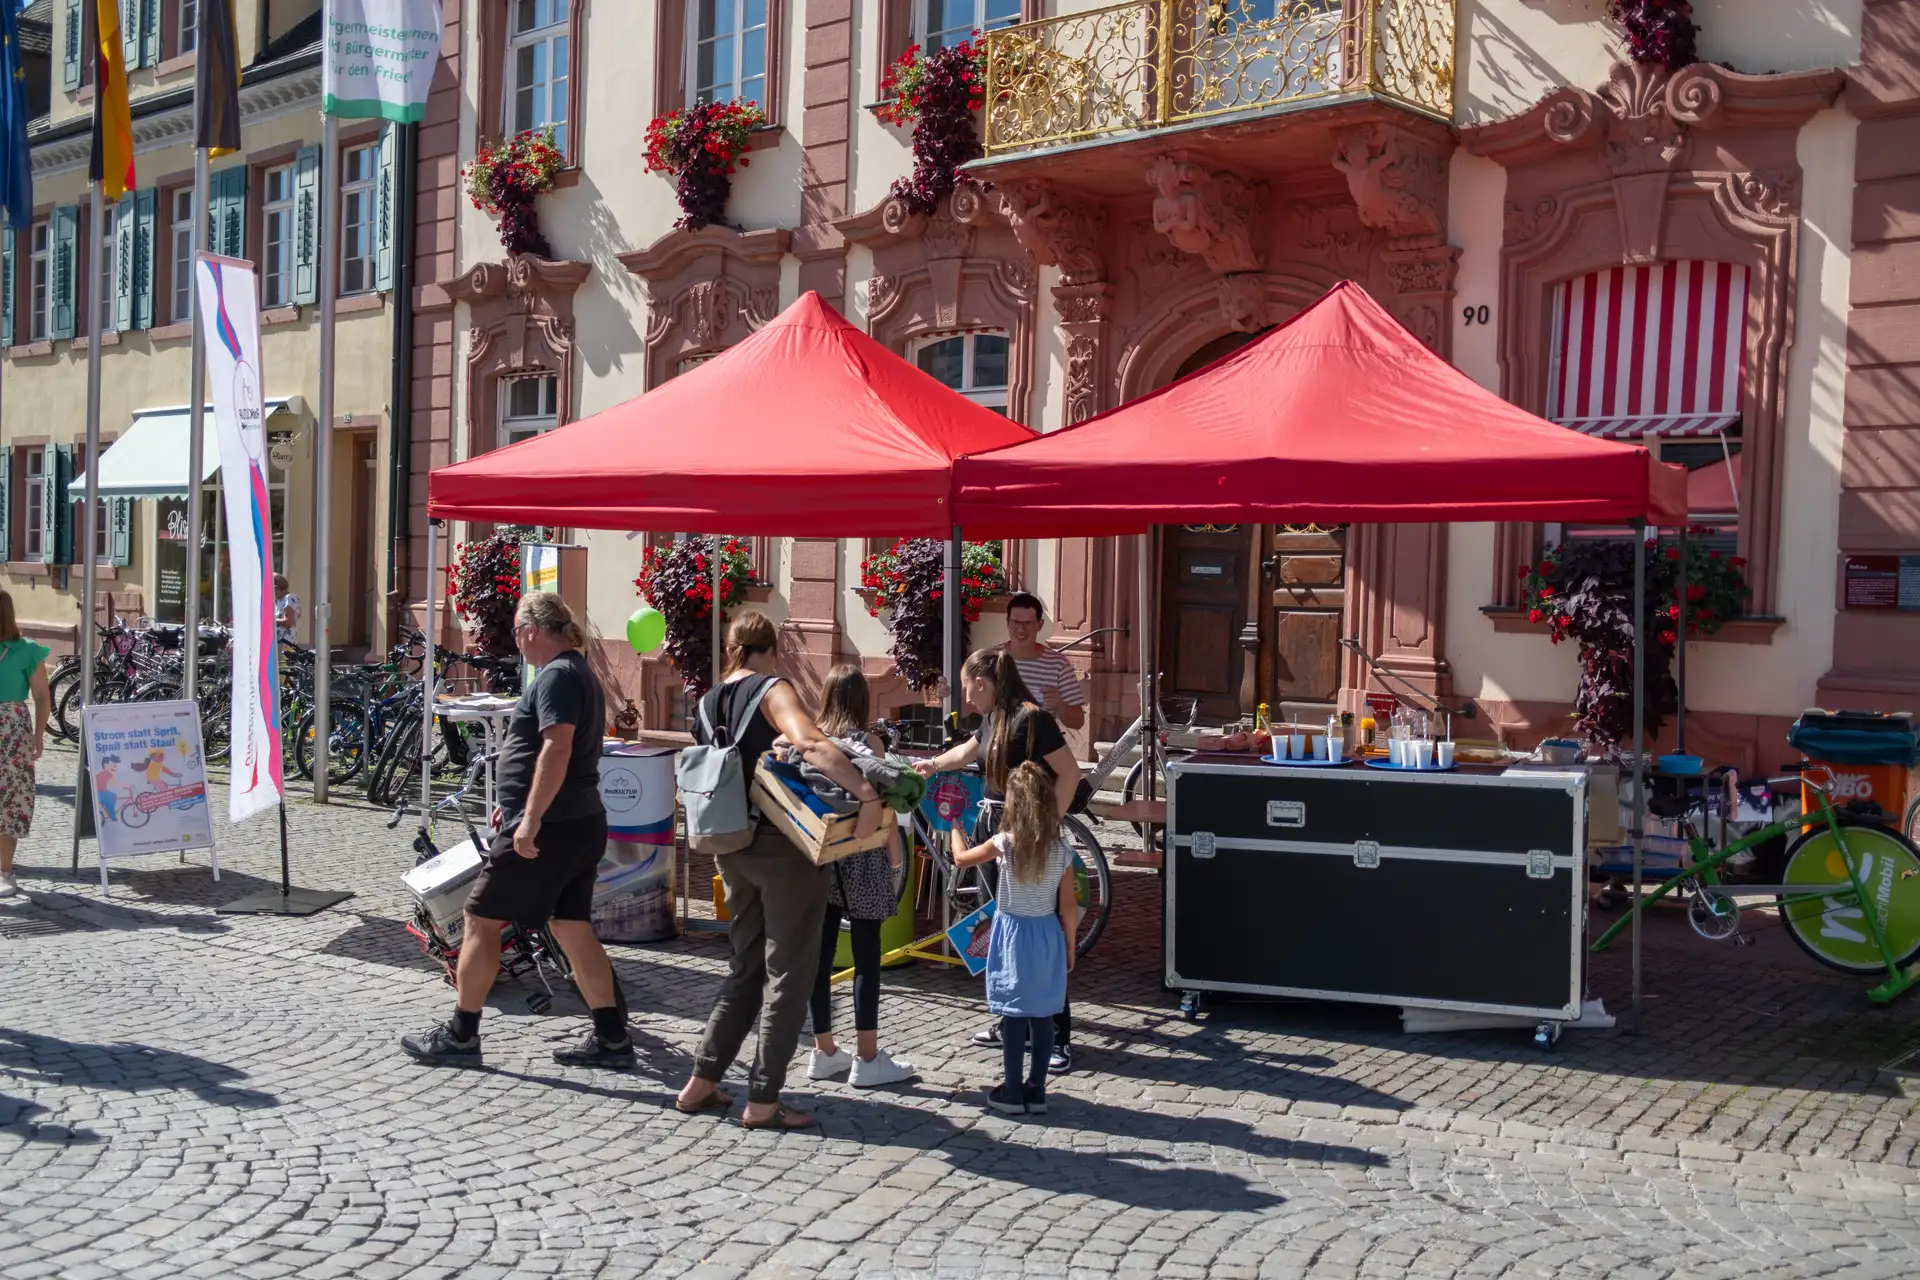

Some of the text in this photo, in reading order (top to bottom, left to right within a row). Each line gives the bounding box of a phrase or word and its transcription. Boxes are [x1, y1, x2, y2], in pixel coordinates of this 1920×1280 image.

[348, 63, 369, 77] den
[1463, 304, 1489, 326] 90
[94, 726, 181, 741] Strom statt Sprit,
[96, 738, 175, 753] Spaß statt Stau!
